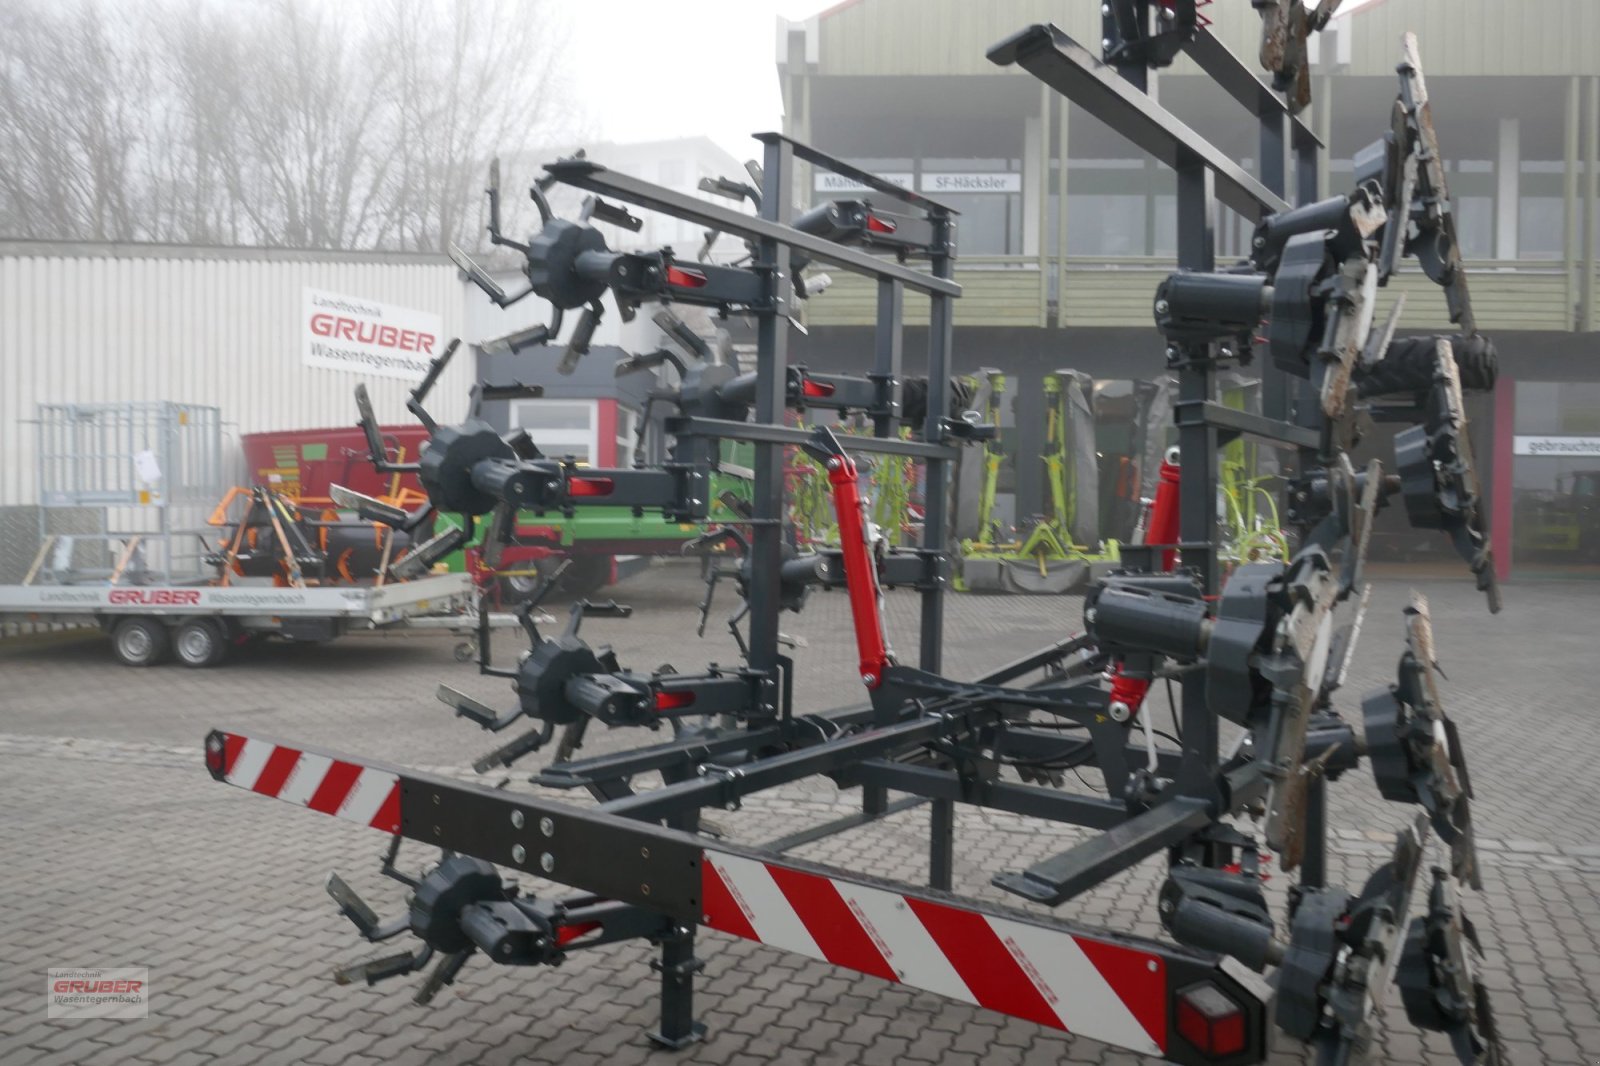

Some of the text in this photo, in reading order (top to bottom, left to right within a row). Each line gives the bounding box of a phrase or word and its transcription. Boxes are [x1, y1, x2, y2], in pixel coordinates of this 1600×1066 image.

[935, 175, 1006, 188] SF-Häcksler
[310, 313, 435, 354] GRUBER
[311, 342, 430, 372] Wasentegernbac
[108, 590, 201, 605] GRUBER
